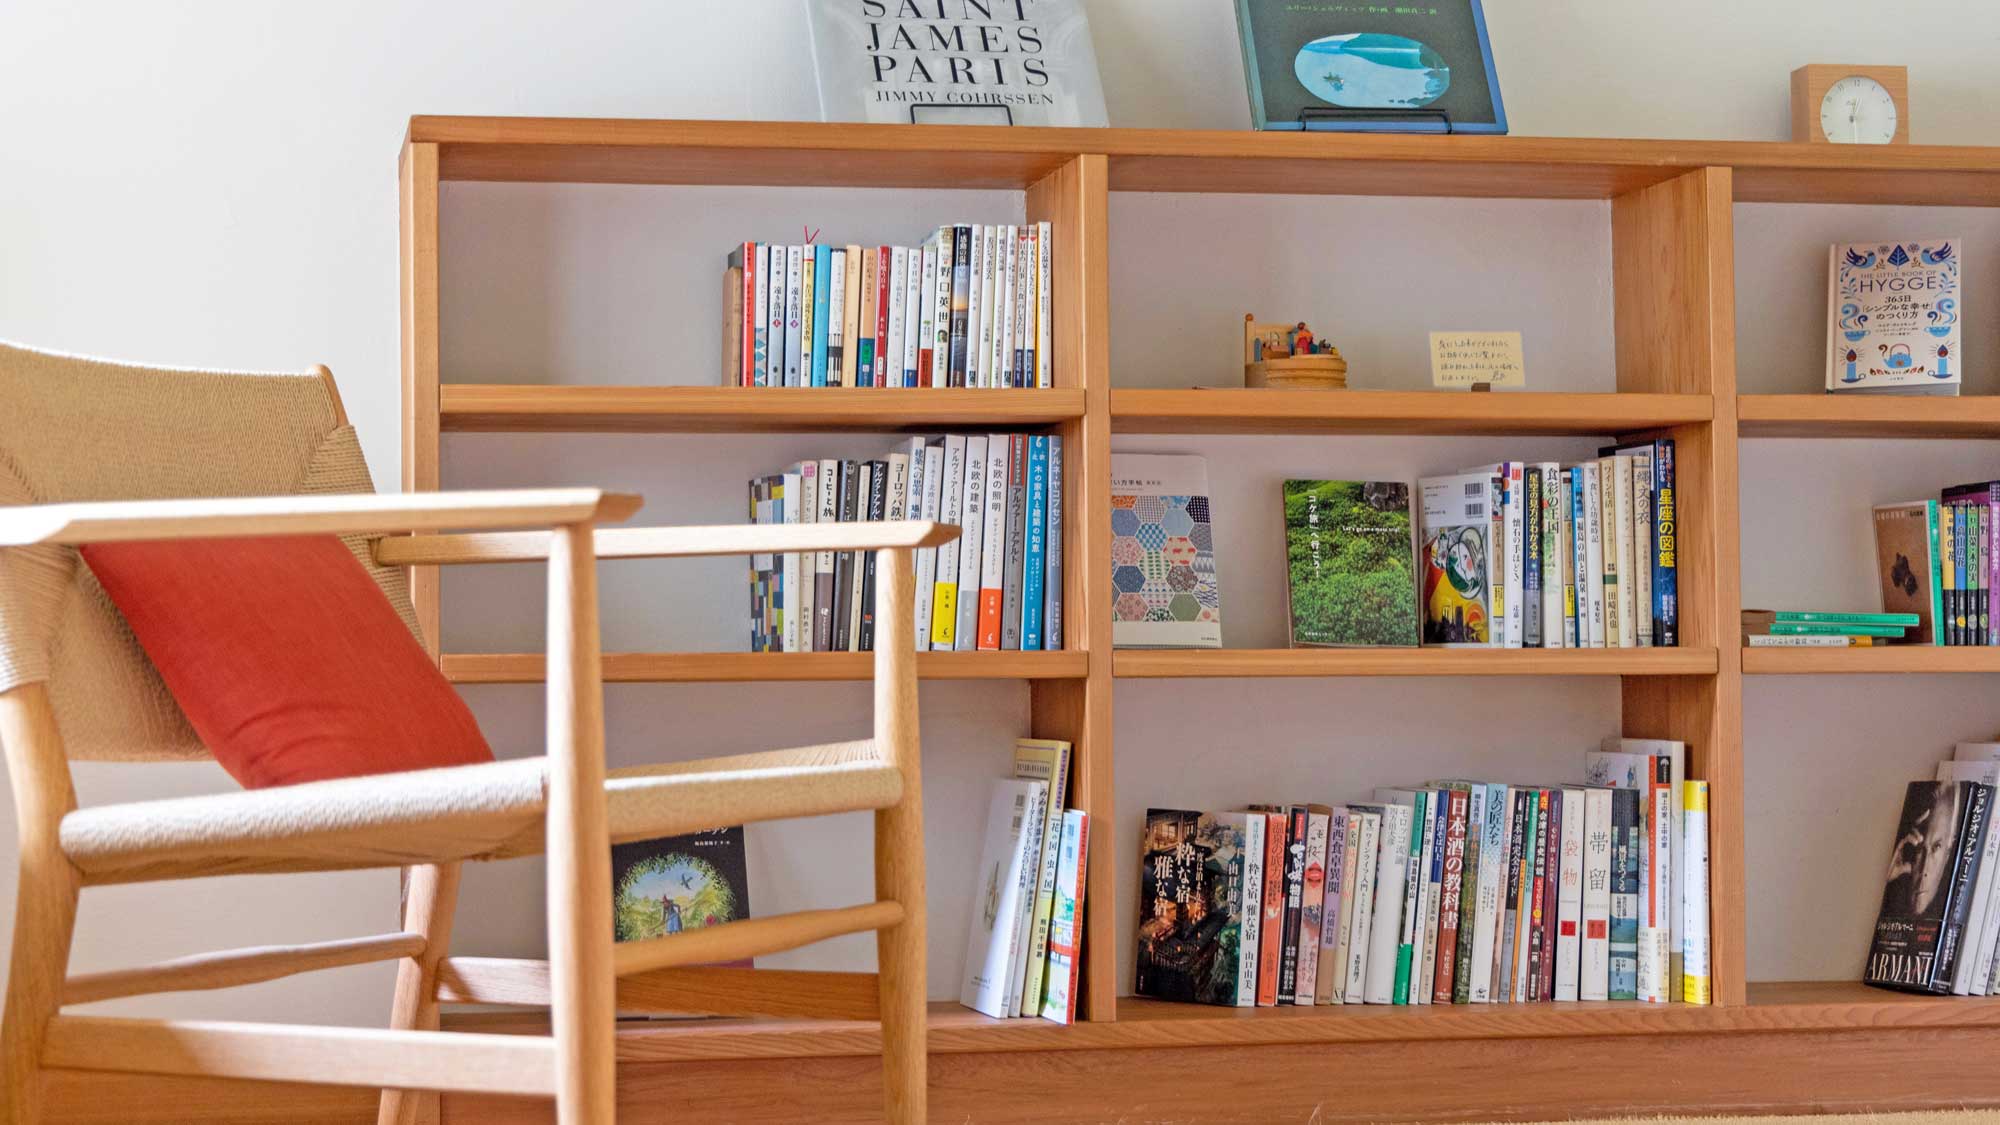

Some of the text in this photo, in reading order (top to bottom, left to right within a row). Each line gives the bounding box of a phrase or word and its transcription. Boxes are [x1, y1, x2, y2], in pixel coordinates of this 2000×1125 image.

[863, 0, 1034, 21] SAINT
[866, 22, 1043, 54] JAMES
[868, 55, 1049, 87] PARIS
[876, 90, 1054, 105] JIMMY COHRSSEN
[938, 266, 951, 323] 野口英世
[1859, 276, 1937, 293] HYGGE
[1884, 294, 1912, 304] 365日
[1876, 310, 1919, 320] のつくり方
[823, 467, 834, 518] コーヒーと旅
[890, 462, 905, 521] ヨーロッパ鉄
[968, 459, 981, 514] 北欧の建築
[991, 458, 1004, 513] 北欧の照明
[1031, 464, 1043, 553] 木の家具と建築の知恵
[1050, 446, 1062, 526] アルネ・ヤコブセン
[1546, 467, 1559, 534] 食彩の王国
[1604, 464, 1613, 508] ワイン生活
[1636, 470, 1650, 525] 縄文の衣
[1658, 488, 1675, 567] 星座の図鑑
[1946, 526, 1955, 561] 野の花
[1957, 526, 1966, 568] 高山の花
[1968, 526, 1978, 582] 山菜・木の実
[1576, 520, 1587, 593] 福島の山と温泉
[1607, 591, 1618, 629] 田崎真也
[1489, 789, 1504, 846] 美の匠たち
[1044, 821, 1060, 889] 花の国・虫の国
[1327, 815, 1345, 895] 東西食卓異聞
[1360, 832, 1372, 892] ワインライフ入門
[1408, 859, 1418, 899] 福島県の山
[1441, 796, 1467, 930] 日本酒の教科書
[1510, 813, 1523, 897] 日本酒完全ガイド
[1563, 839, 1578, 888] 袋物
[1590, 831, 1608, 891] 帯留
[1153, 855, 1174, 917] 雅な宿
[1244, 862, 1260, 990] 粋な宿、雅な宿 山口由美
[1867, 952, 1934, 986] ARMANI
